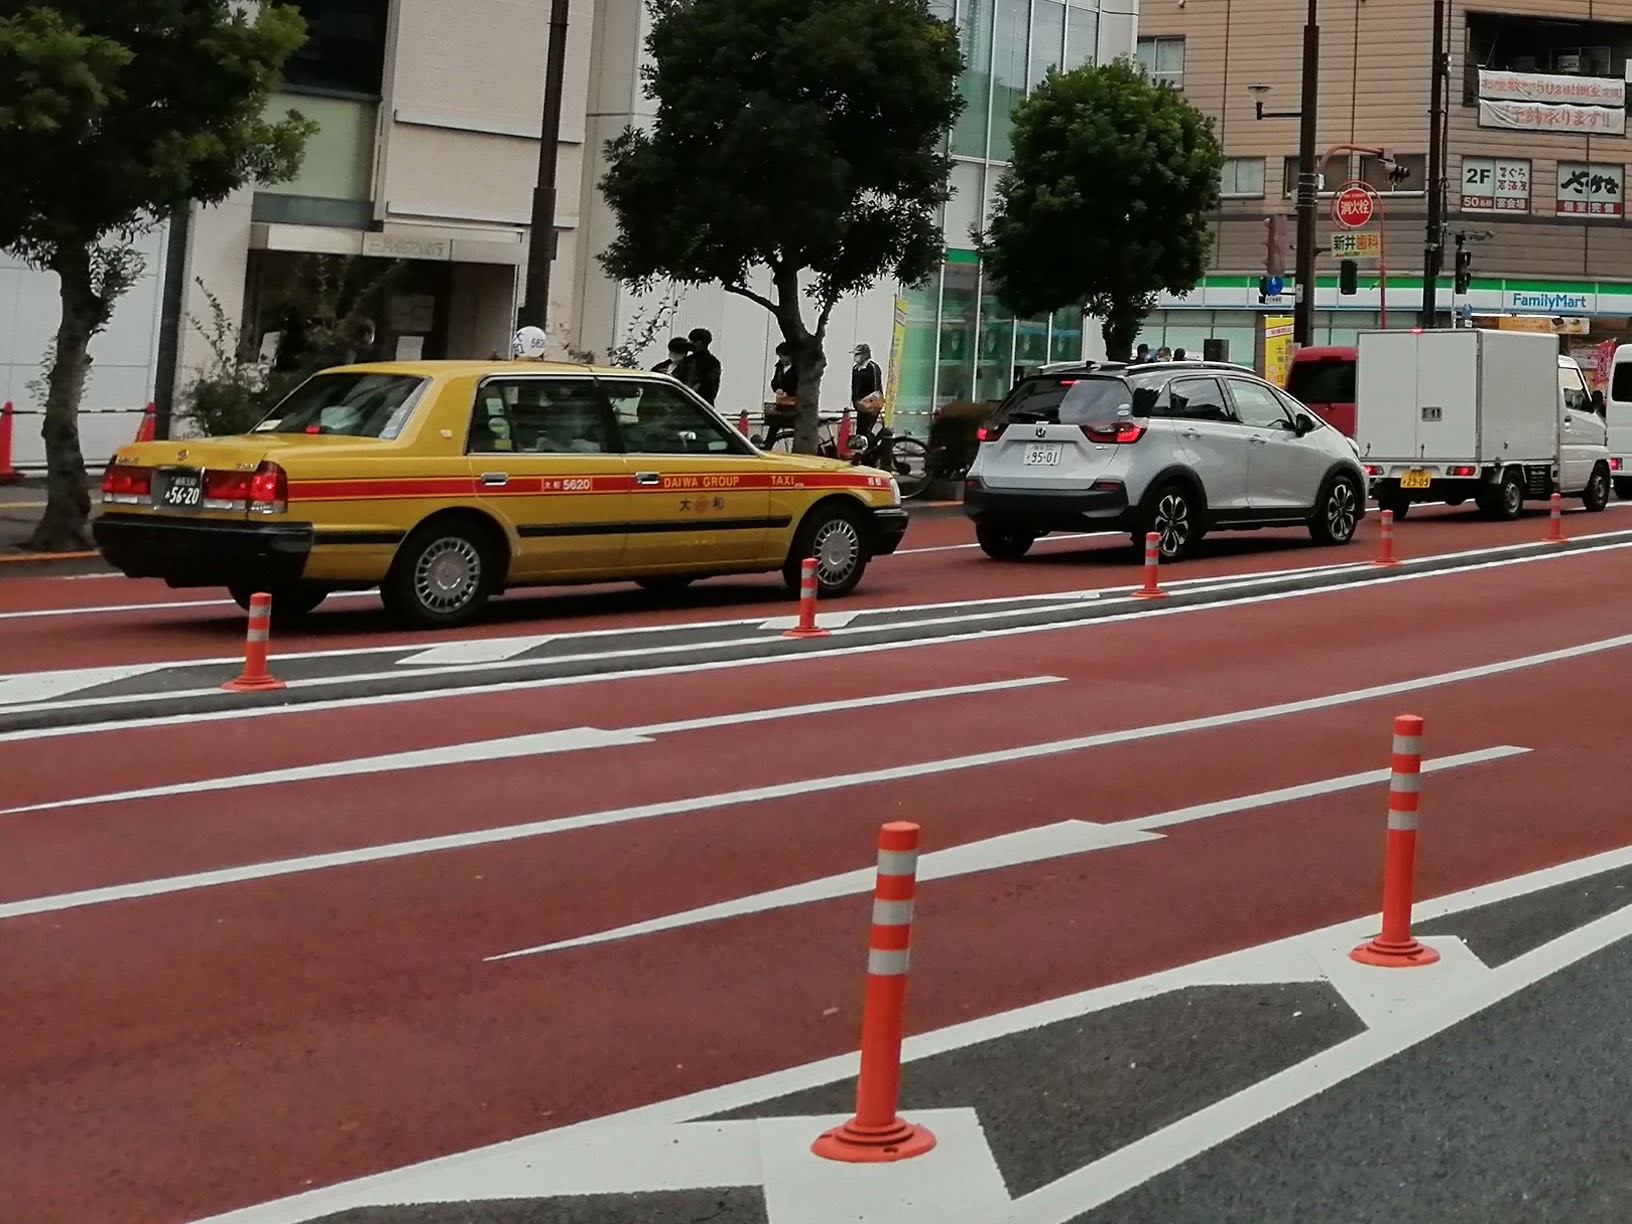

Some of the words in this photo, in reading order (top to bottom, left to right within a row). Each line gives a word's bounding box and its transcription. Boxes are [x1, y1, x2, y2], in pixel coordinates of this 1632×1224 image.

[1466, 168, 1491, 184] 2F
[1341, 199, 1370, 215] 消火栓
[1333, 235, 1378, 251] 新井歯科
[1513, 293, 1587, 311] FamilyMart
[563, 479, 591, 491] 5620
[664, 477, 699, 489] DAIWA
[702, 476, 740, 488] GROUP
[771, 475, 795, 486] TAXI
[169, 486, 200, 505] 56-20
